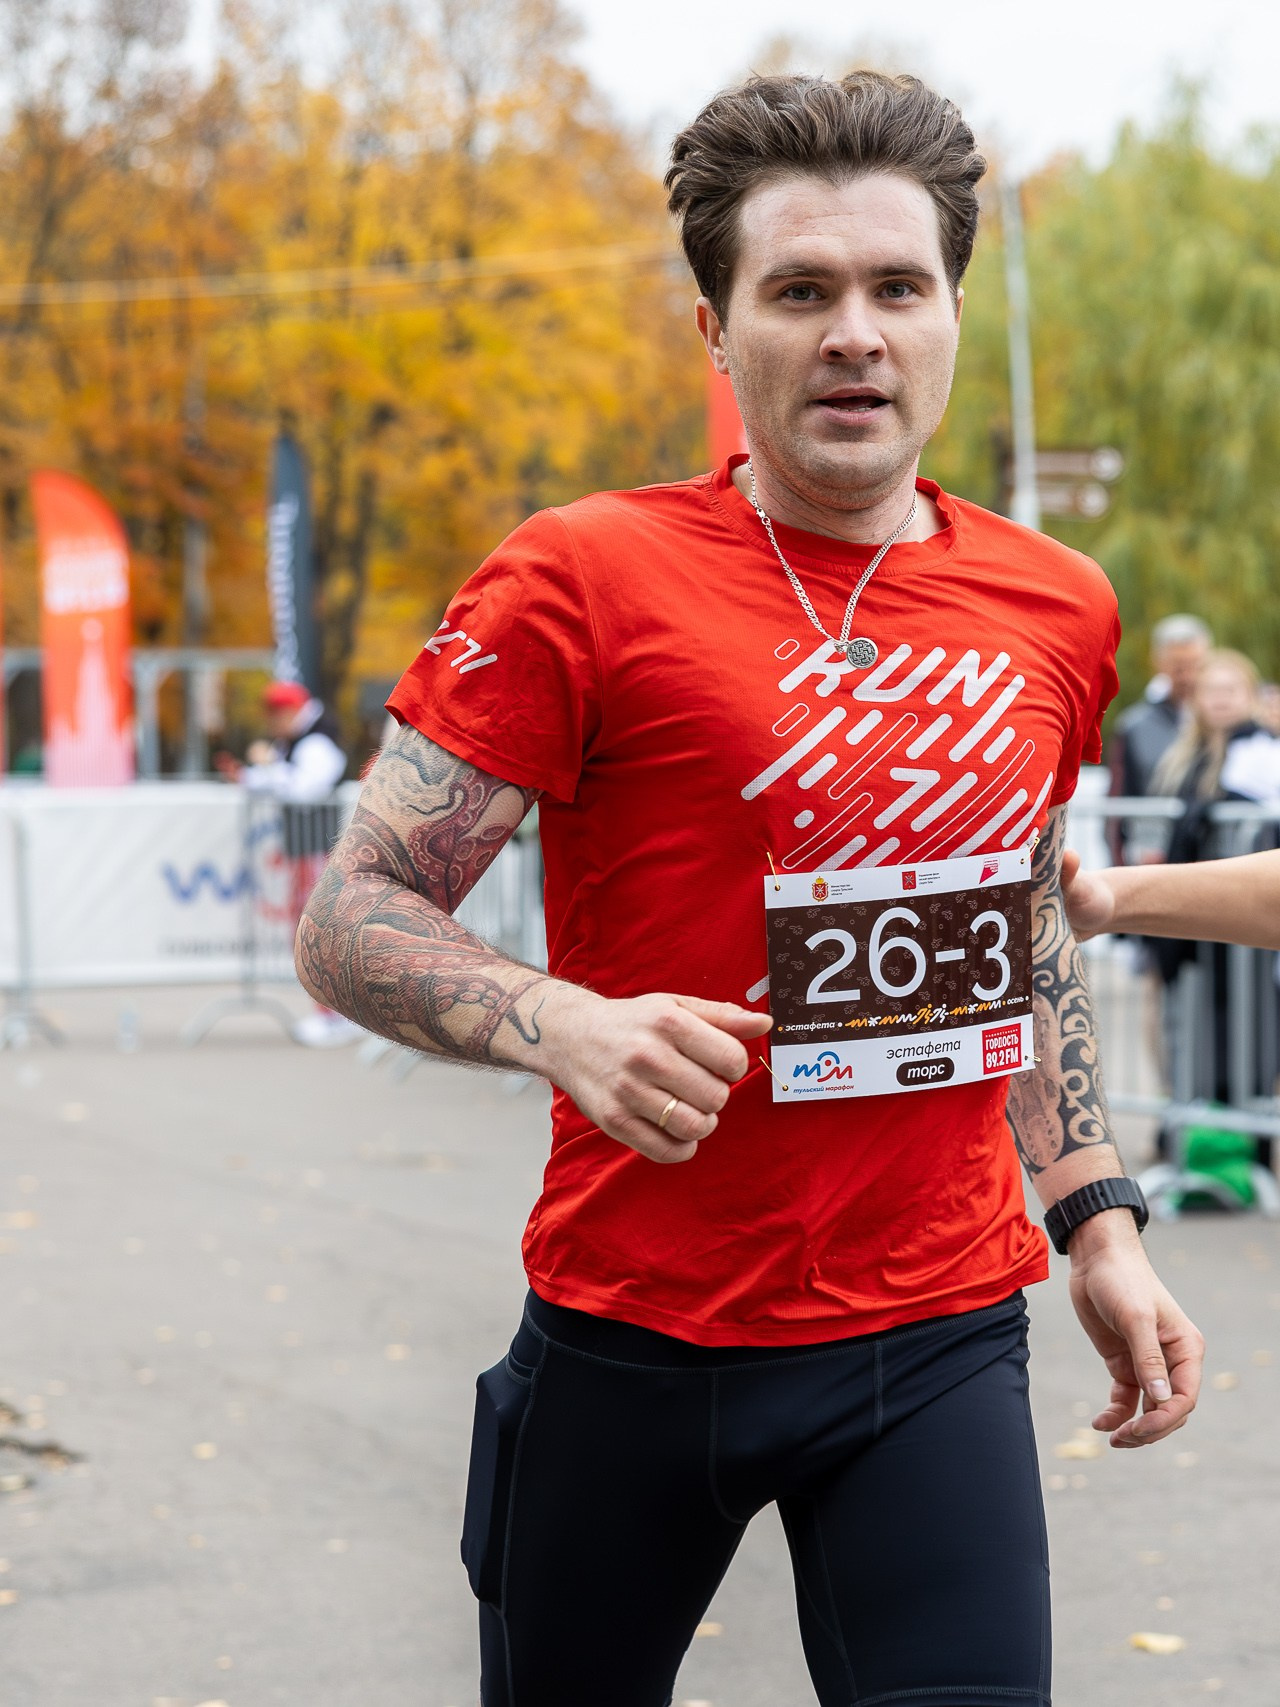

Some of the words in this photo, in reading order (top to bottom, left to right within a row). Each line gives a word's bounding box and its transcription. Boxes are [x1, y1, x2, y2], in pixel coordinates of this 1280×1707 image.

[778, 639, 1011, 707] RUN
[805, 907, 1011, 1004] 26-3
[785, 1020, 836, 1033] эстафета
[886, 1039, 961, 1059] эстафета
[985, 1034, 1019, 1051] ГОРДОСТЬ
[986, 1051, 1005, 1068] 89.2
[1005, 1048, 1019, 1065] FM
[793, 1085, 824, 1094] тульский
[825, 1084, 855, 1093] марафон
